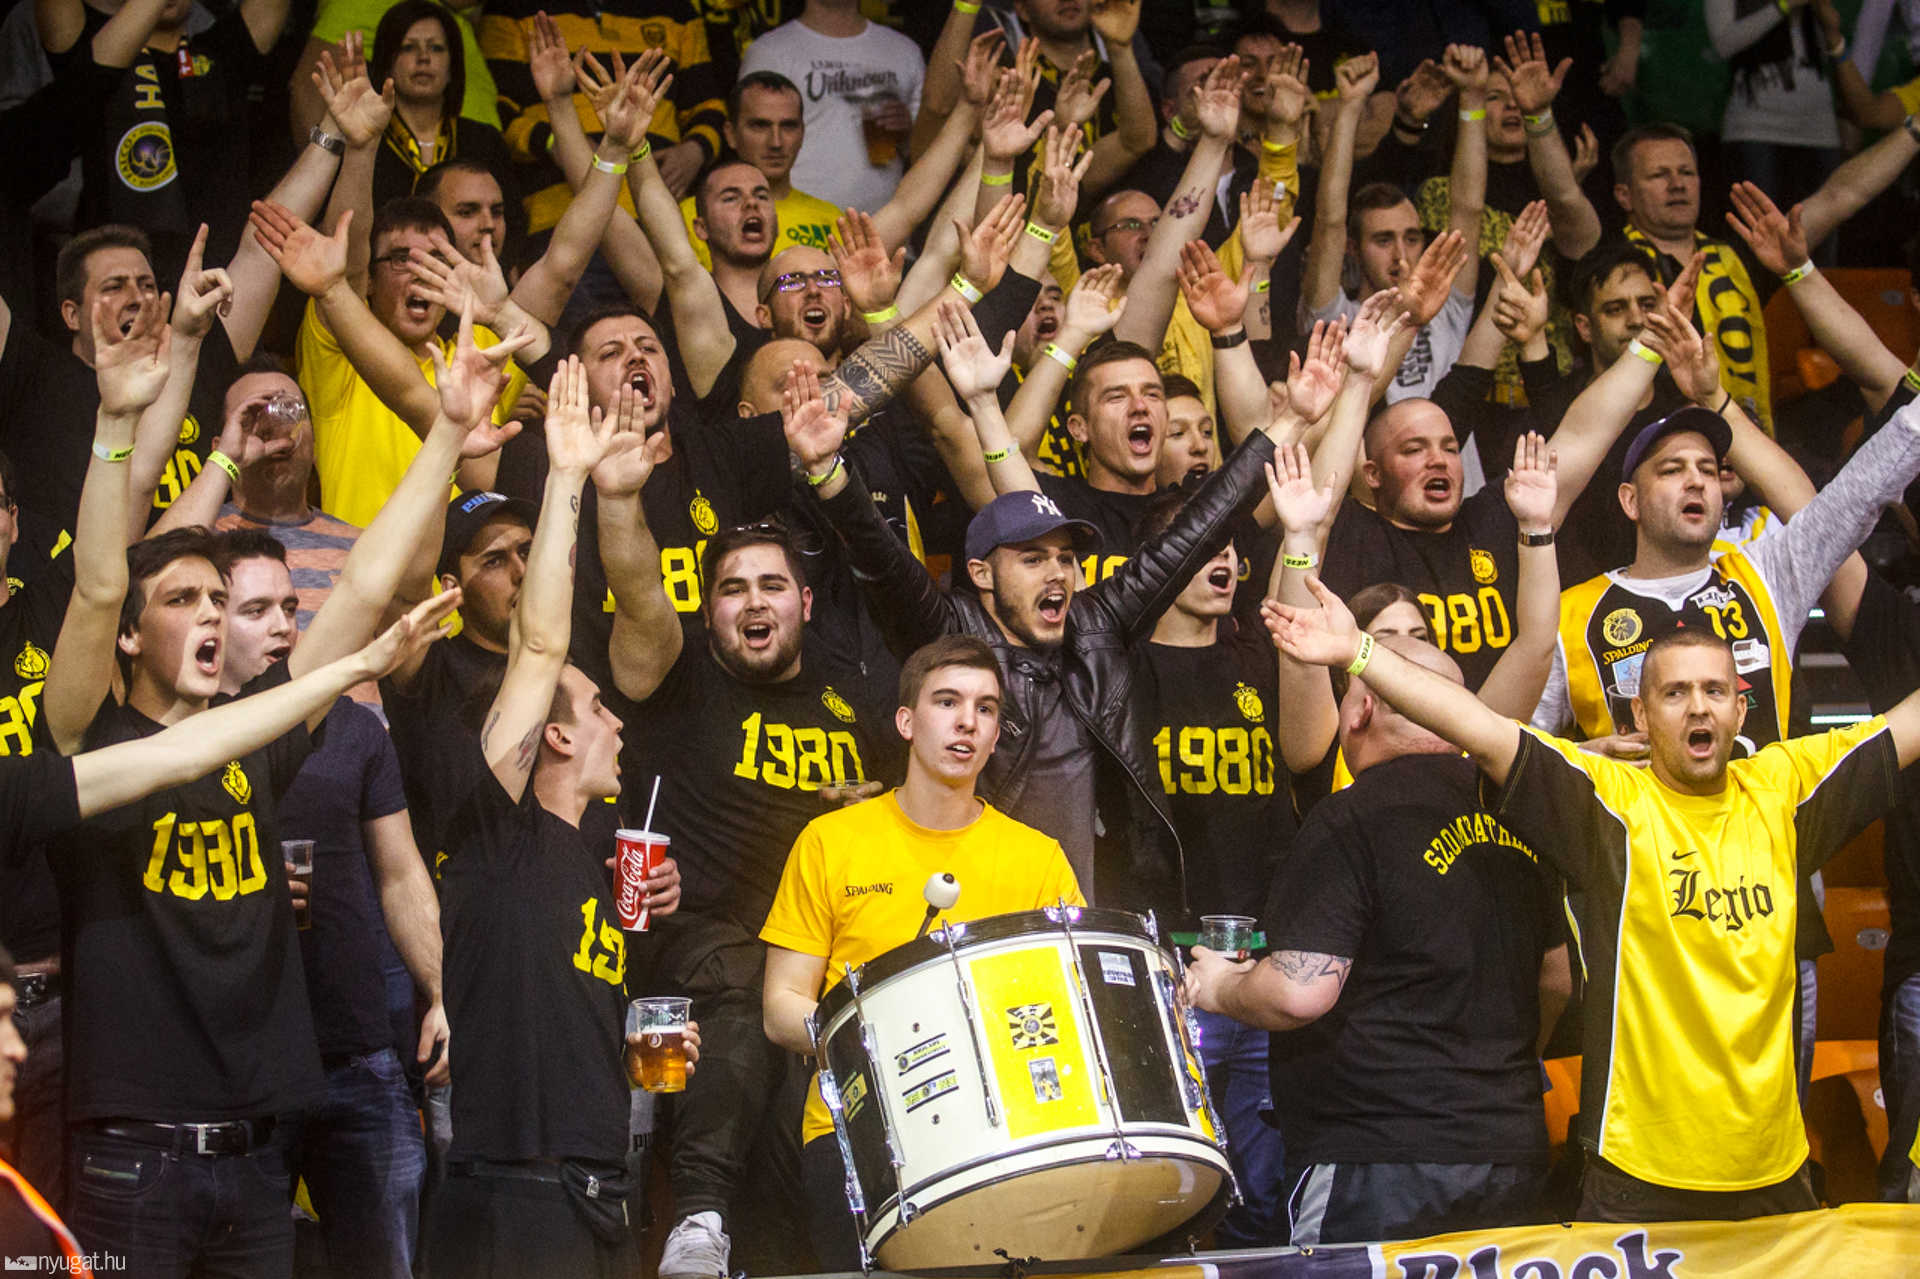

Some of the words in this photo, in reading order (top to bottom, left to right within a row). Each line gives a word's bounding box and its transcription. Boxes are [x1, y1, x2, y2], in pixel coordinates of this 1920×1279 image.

[733, 711, 866, 792] 1980
[1152, 726, 1275, 795] 1980
[1668, 868, 1774, 932] Legio
